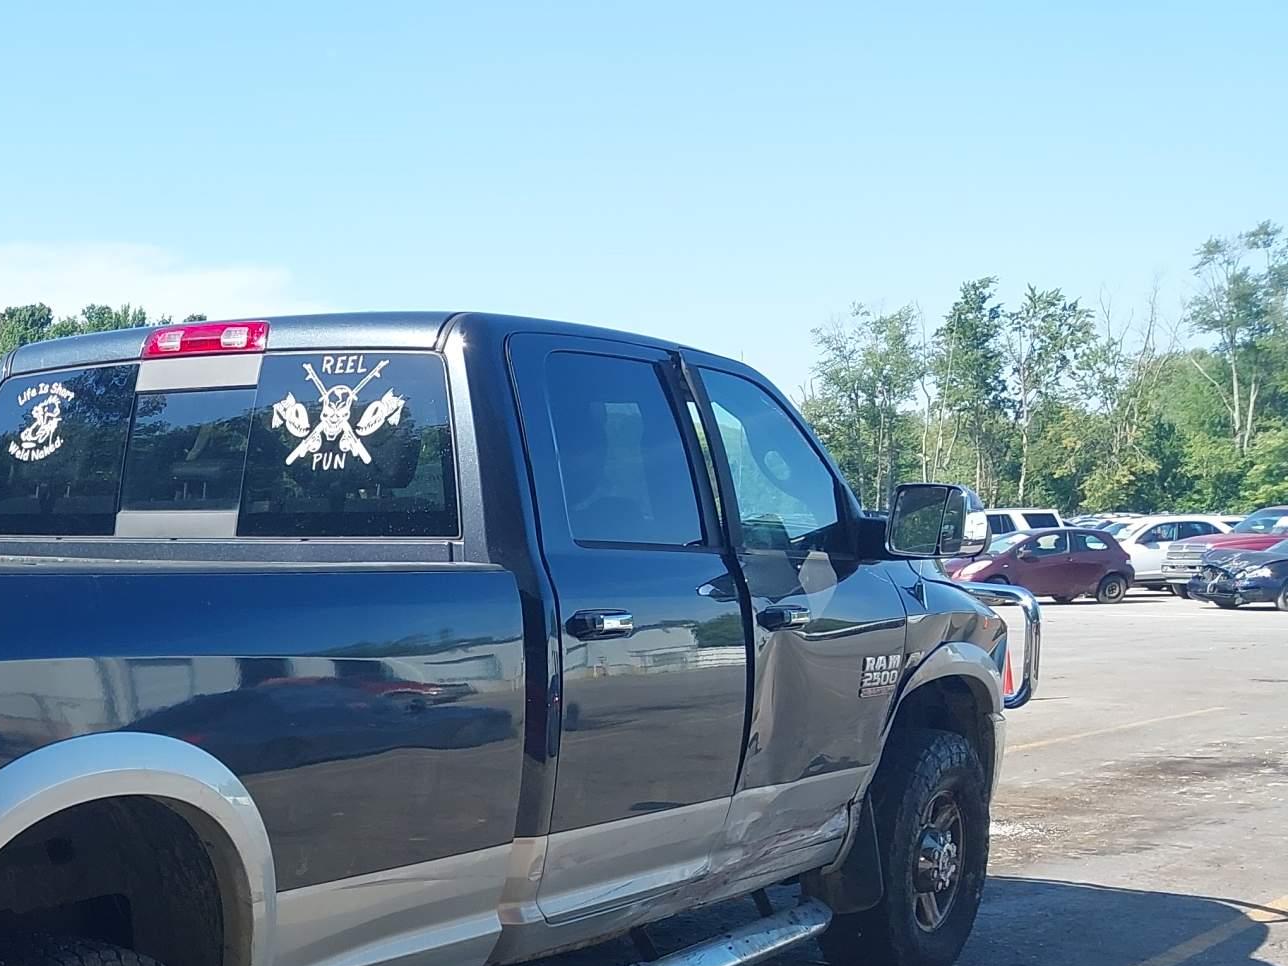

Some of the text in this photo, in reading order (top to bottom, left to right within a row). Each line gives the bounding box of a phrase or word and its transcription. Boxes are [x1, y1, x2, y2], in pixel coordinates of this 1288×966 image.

[322, 355, 367, 374] REEL
[18, 382, 75, 406] Life Is Short
[8, 440, 30, 461] Weld
[312, 452, 346, 471] PUN
[864, 655, 901, 671] RAM
[862, 670, 899, 687] 2500
